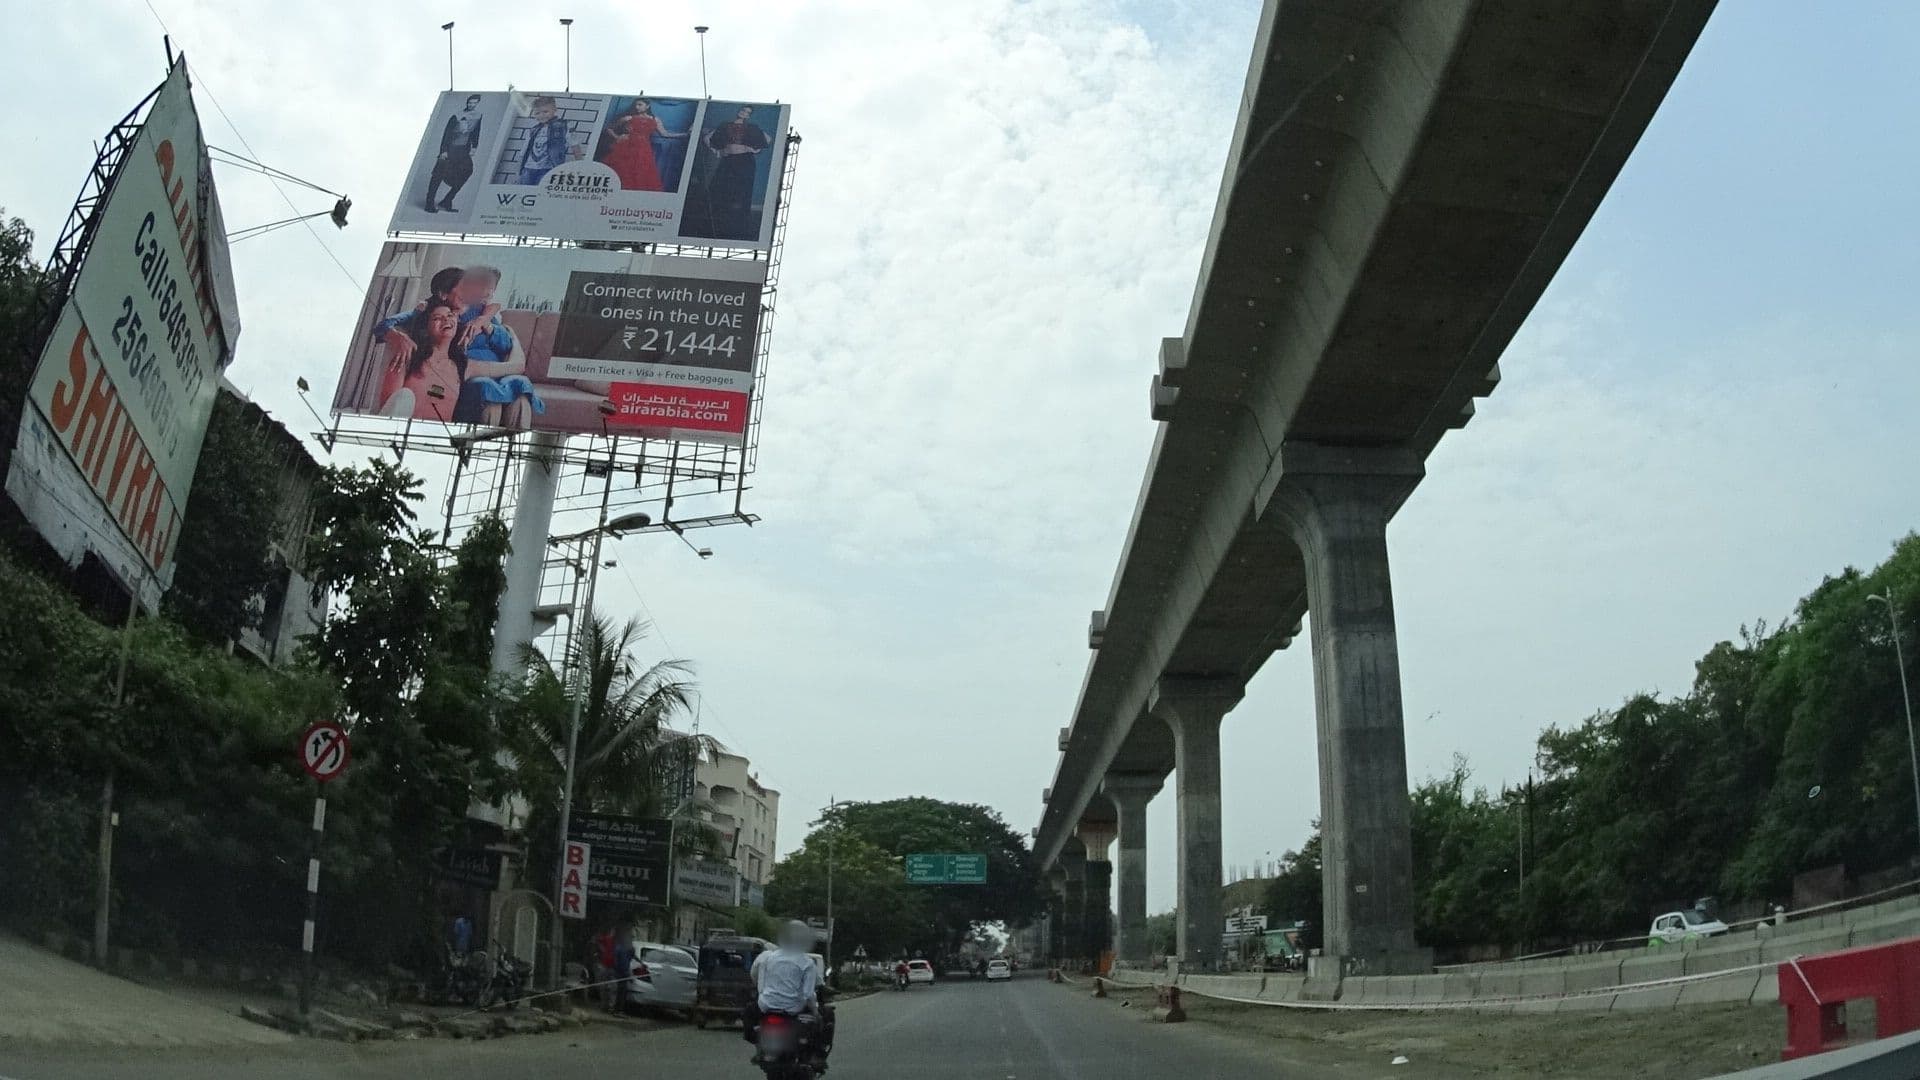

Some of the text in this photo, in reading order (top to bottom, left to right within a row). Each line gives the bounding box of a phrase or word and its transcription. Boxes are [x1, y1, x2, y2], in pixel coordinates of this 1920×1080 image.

[547, 185, 608, 194] COLLECTION
[550, 174, 611, 187] FESTIVE
[600, 206, 673, 219] Bombaywala
[583, 282, 745, 306] Connect with loved
[601, 307, 743, 328] ones in the UAE
[565, 363, 596, 373] Return
[598, 366, 625, 376] Ticket
[636, 369, 654, 378] Visa
[665, 370, 686, 380] Free
[688, 373, 734, 386] baggages
[620, 402, 728, 422] airarabia.com
[51, 324, 177, 571] SHIVRAJ
[562, 844, 584, 914] BAR
